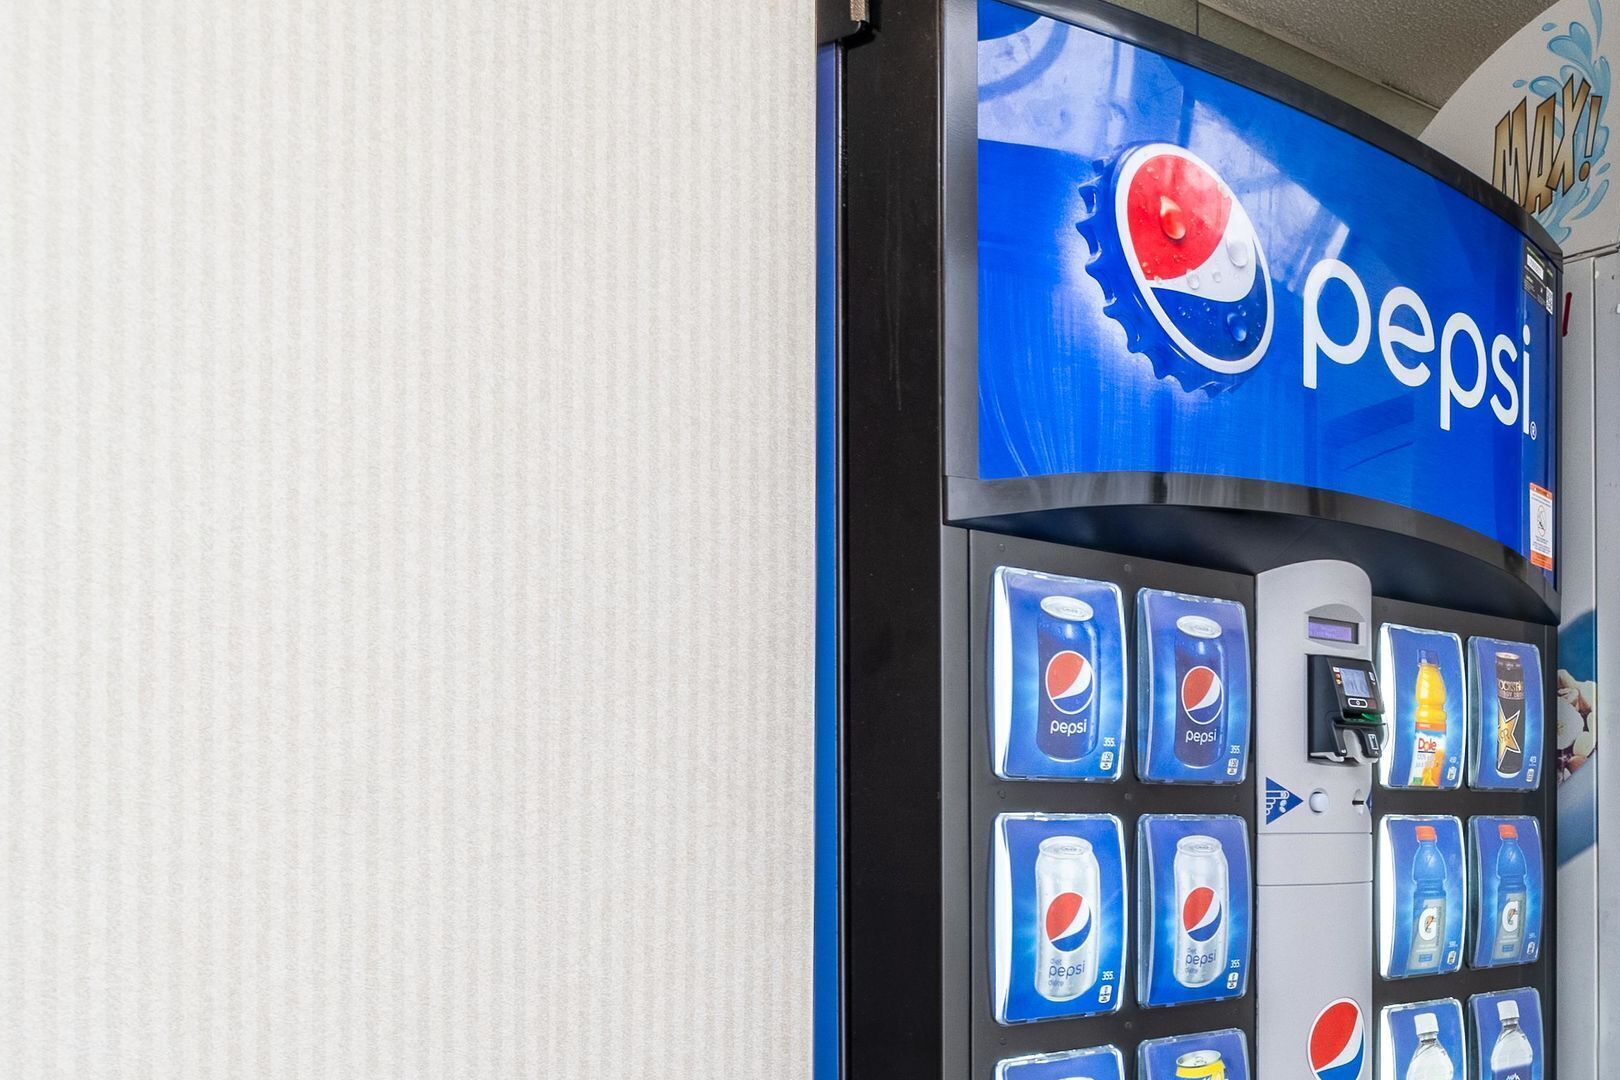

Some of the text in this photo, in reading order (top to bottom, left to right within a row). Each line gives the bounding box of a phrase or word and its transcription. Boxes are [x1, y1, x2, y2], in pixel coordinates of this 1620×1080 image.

[1491, 73, 1603, 216] MAX!
[1303, 258, 1531, 436] pepsi
[1050, 719, 1088, 737] pepsi
[1185, 729, 1218, 746] pepsi
[1418, 737, 1438, 751] Dole
[1185, 950, 1217, 967] pepsi
[1049, 960, 1086, 980] pepsi
